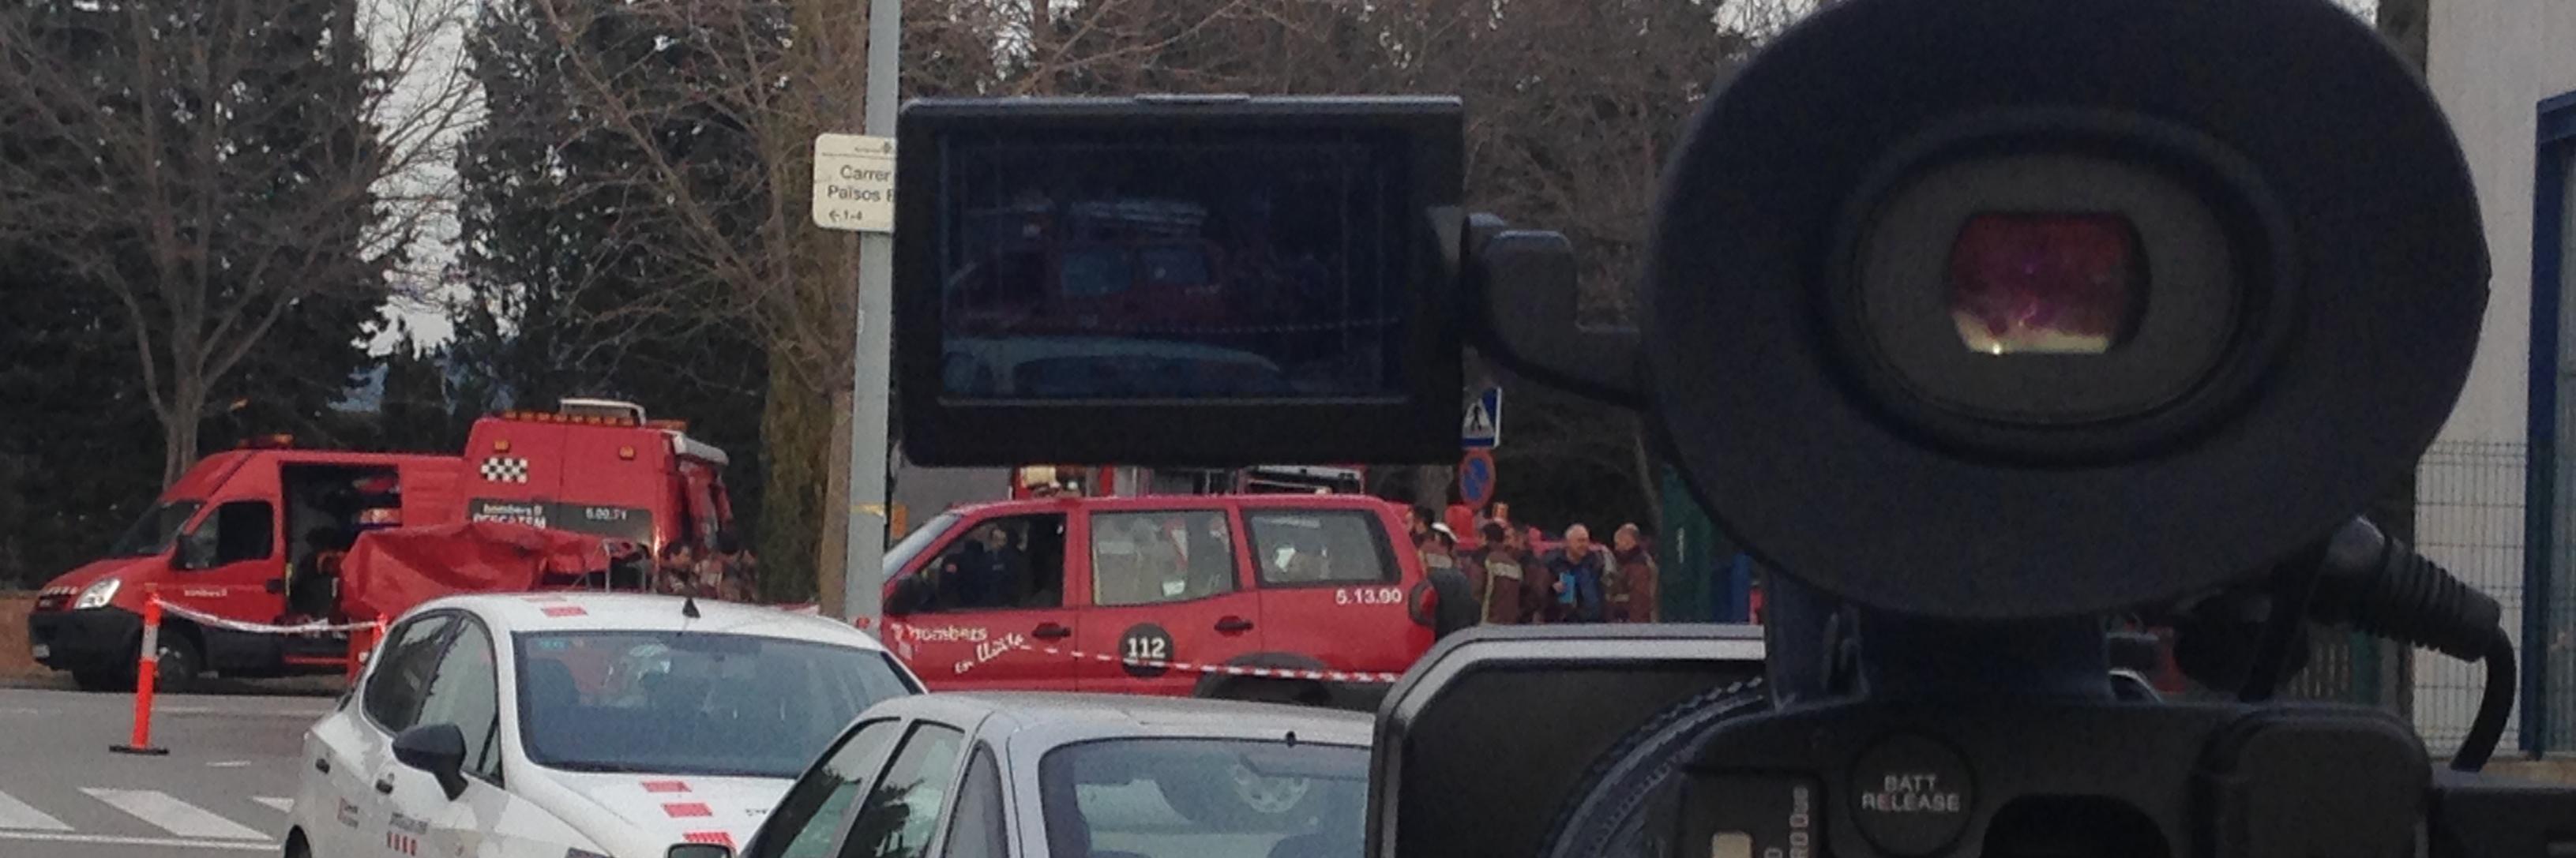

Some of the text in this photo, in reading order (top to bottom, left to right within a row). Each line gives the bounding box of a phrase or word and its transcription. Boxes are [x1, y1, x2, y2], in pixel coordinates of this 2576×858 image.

[839, 164, 892, 182] Carrer
[1128, 636, 1166, 658] 112
[1884, 774, 1936, 792] BATT
[1861, 792, 1959, 812] RELEASE
